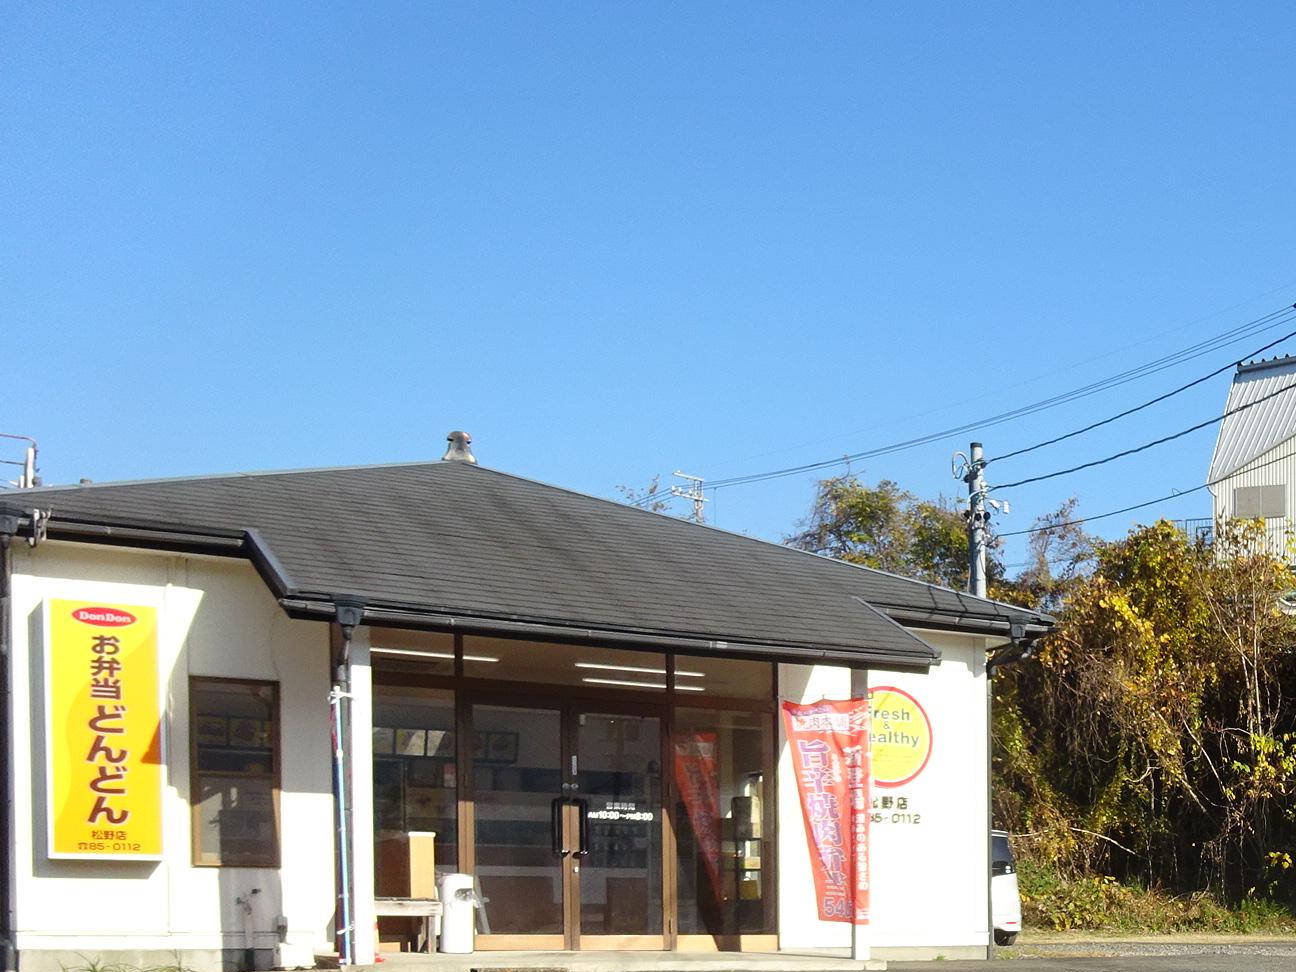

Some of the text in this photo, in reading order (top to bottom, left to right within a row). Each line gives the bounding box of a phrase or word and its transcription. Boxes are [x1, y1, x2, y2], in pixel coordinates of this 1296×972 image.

[79, 611, 131, 623] DonDon
[868, 708, 910, 721] resh
[86, 634, 130, 824] お弁当どんどん
[883, 721, 891, 730] &
[91, 830, 127, 841] 松野店
